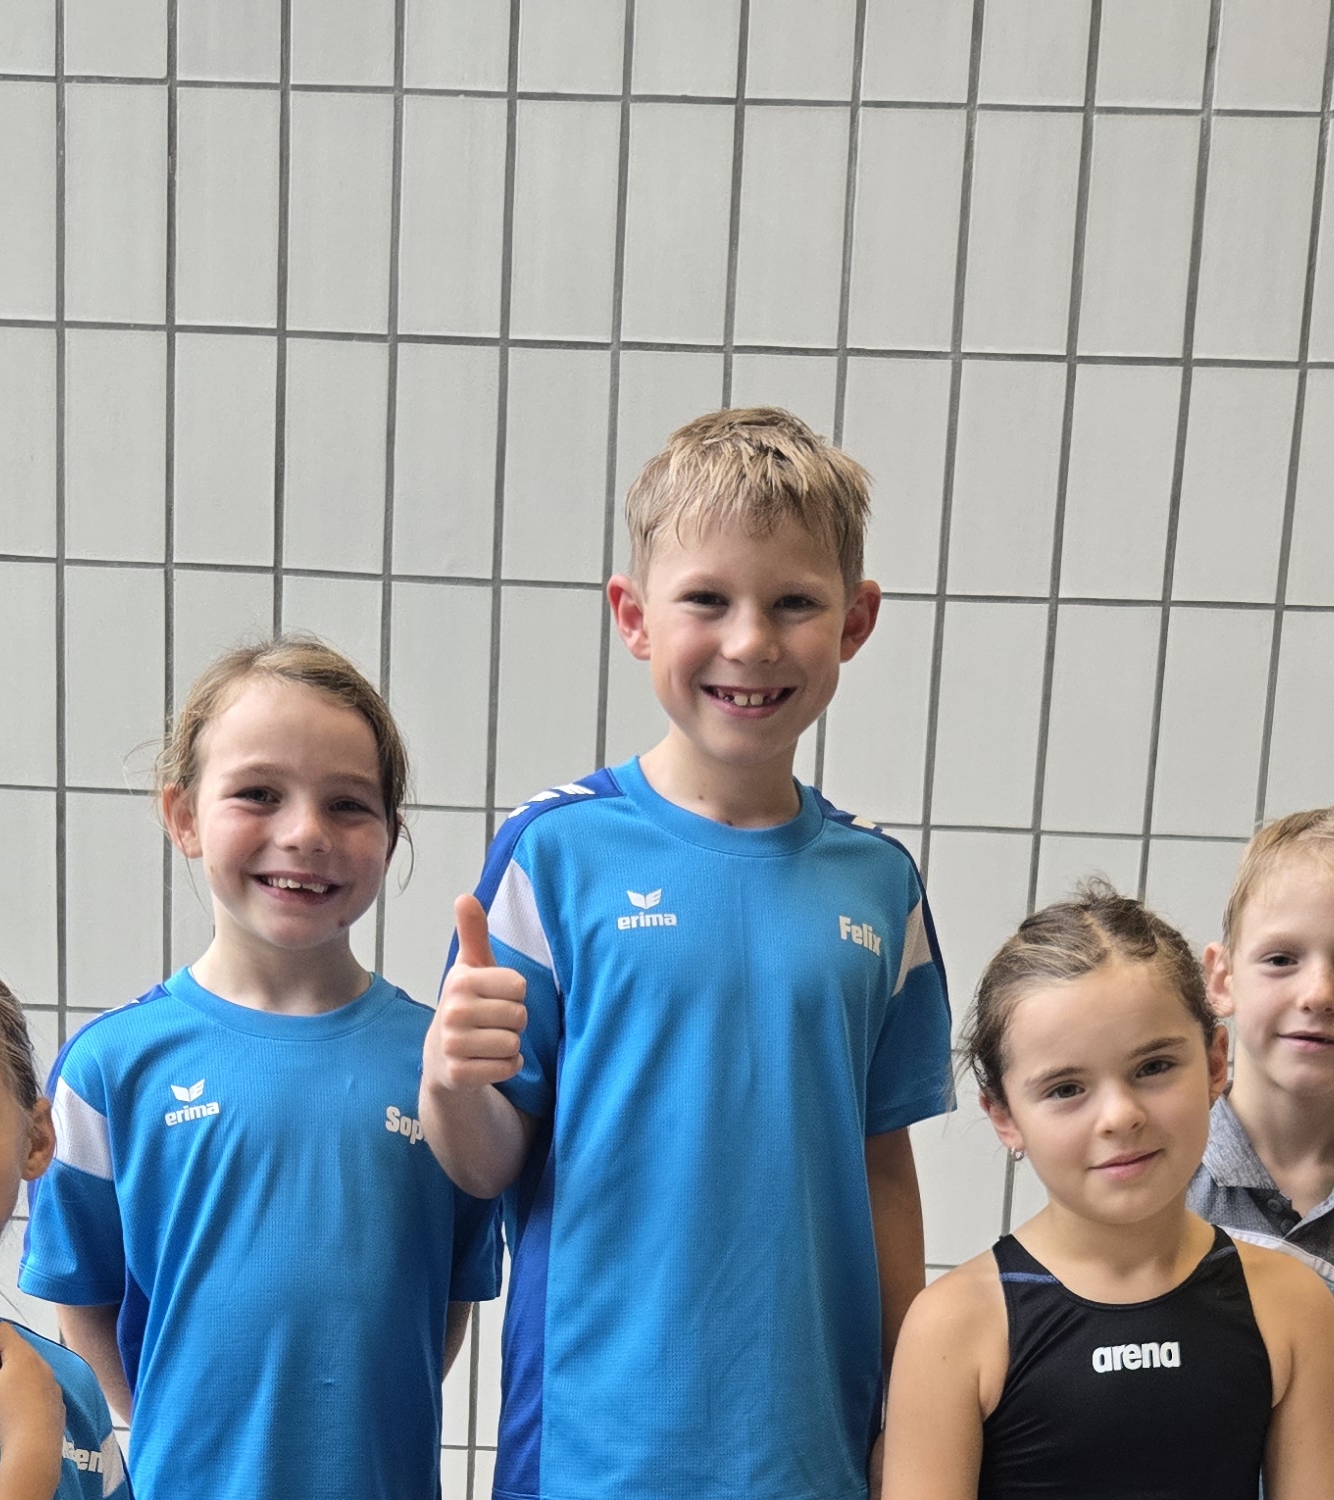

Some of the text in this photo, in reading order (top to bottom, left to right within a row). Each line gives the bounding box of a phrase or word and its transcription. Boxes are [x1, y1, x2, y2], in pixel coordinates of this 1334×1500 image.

[617, 911, 677, 931] erima
[838, 915, 882, 957] Felix
[164, 1101, 220, 1127] erima
[385, 1105, 428, 1145] Sop
[1092, 1341, 1181, 1373] arena
